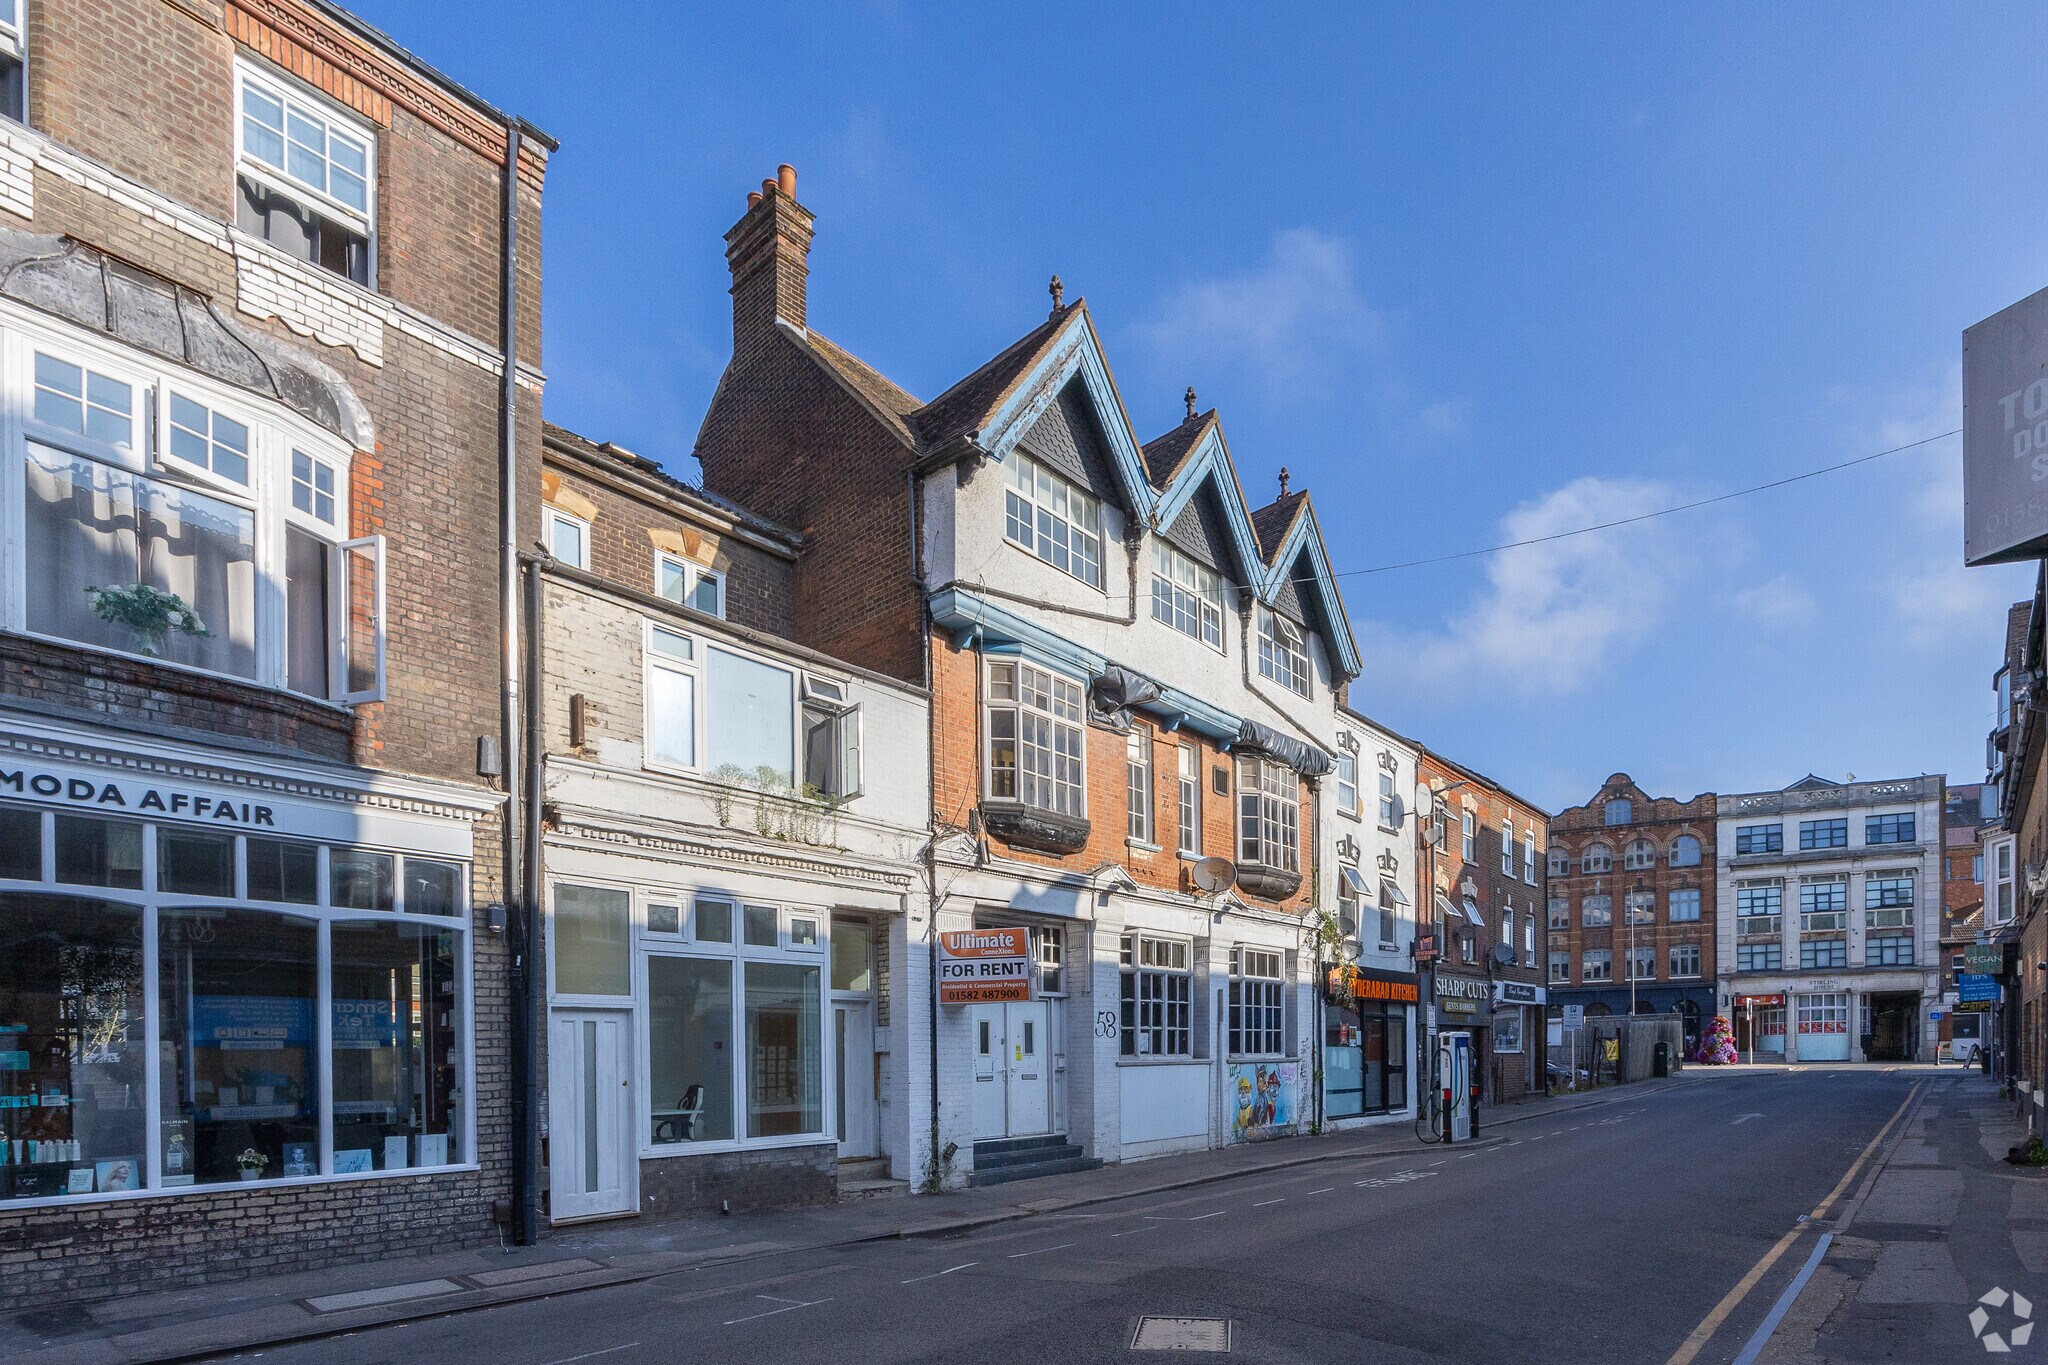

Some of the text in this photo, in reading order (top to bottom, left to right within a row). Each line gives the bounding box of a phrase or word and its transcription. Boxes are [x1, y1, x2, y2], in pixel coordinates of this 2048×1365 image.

[0, 769, 275, 826] MODA AFFAIR
[950, 932, 1015, 950] Ultimate
[980, 948, 1015, 956] ConneXions
[1965, 955, 2003, 963] VEGAN
[942, 961, 1025, 978] FOR RENT
[948, 988, 1020, 1000] 01582 487900
[1348, 978, 1418, 1001] YDERABAD KITCHEN
[1436, 977, 1465, 997] SHARP
[1467, 981, 1488, 999] CUTS
[1095, 1011, 1117, 1039] 58
